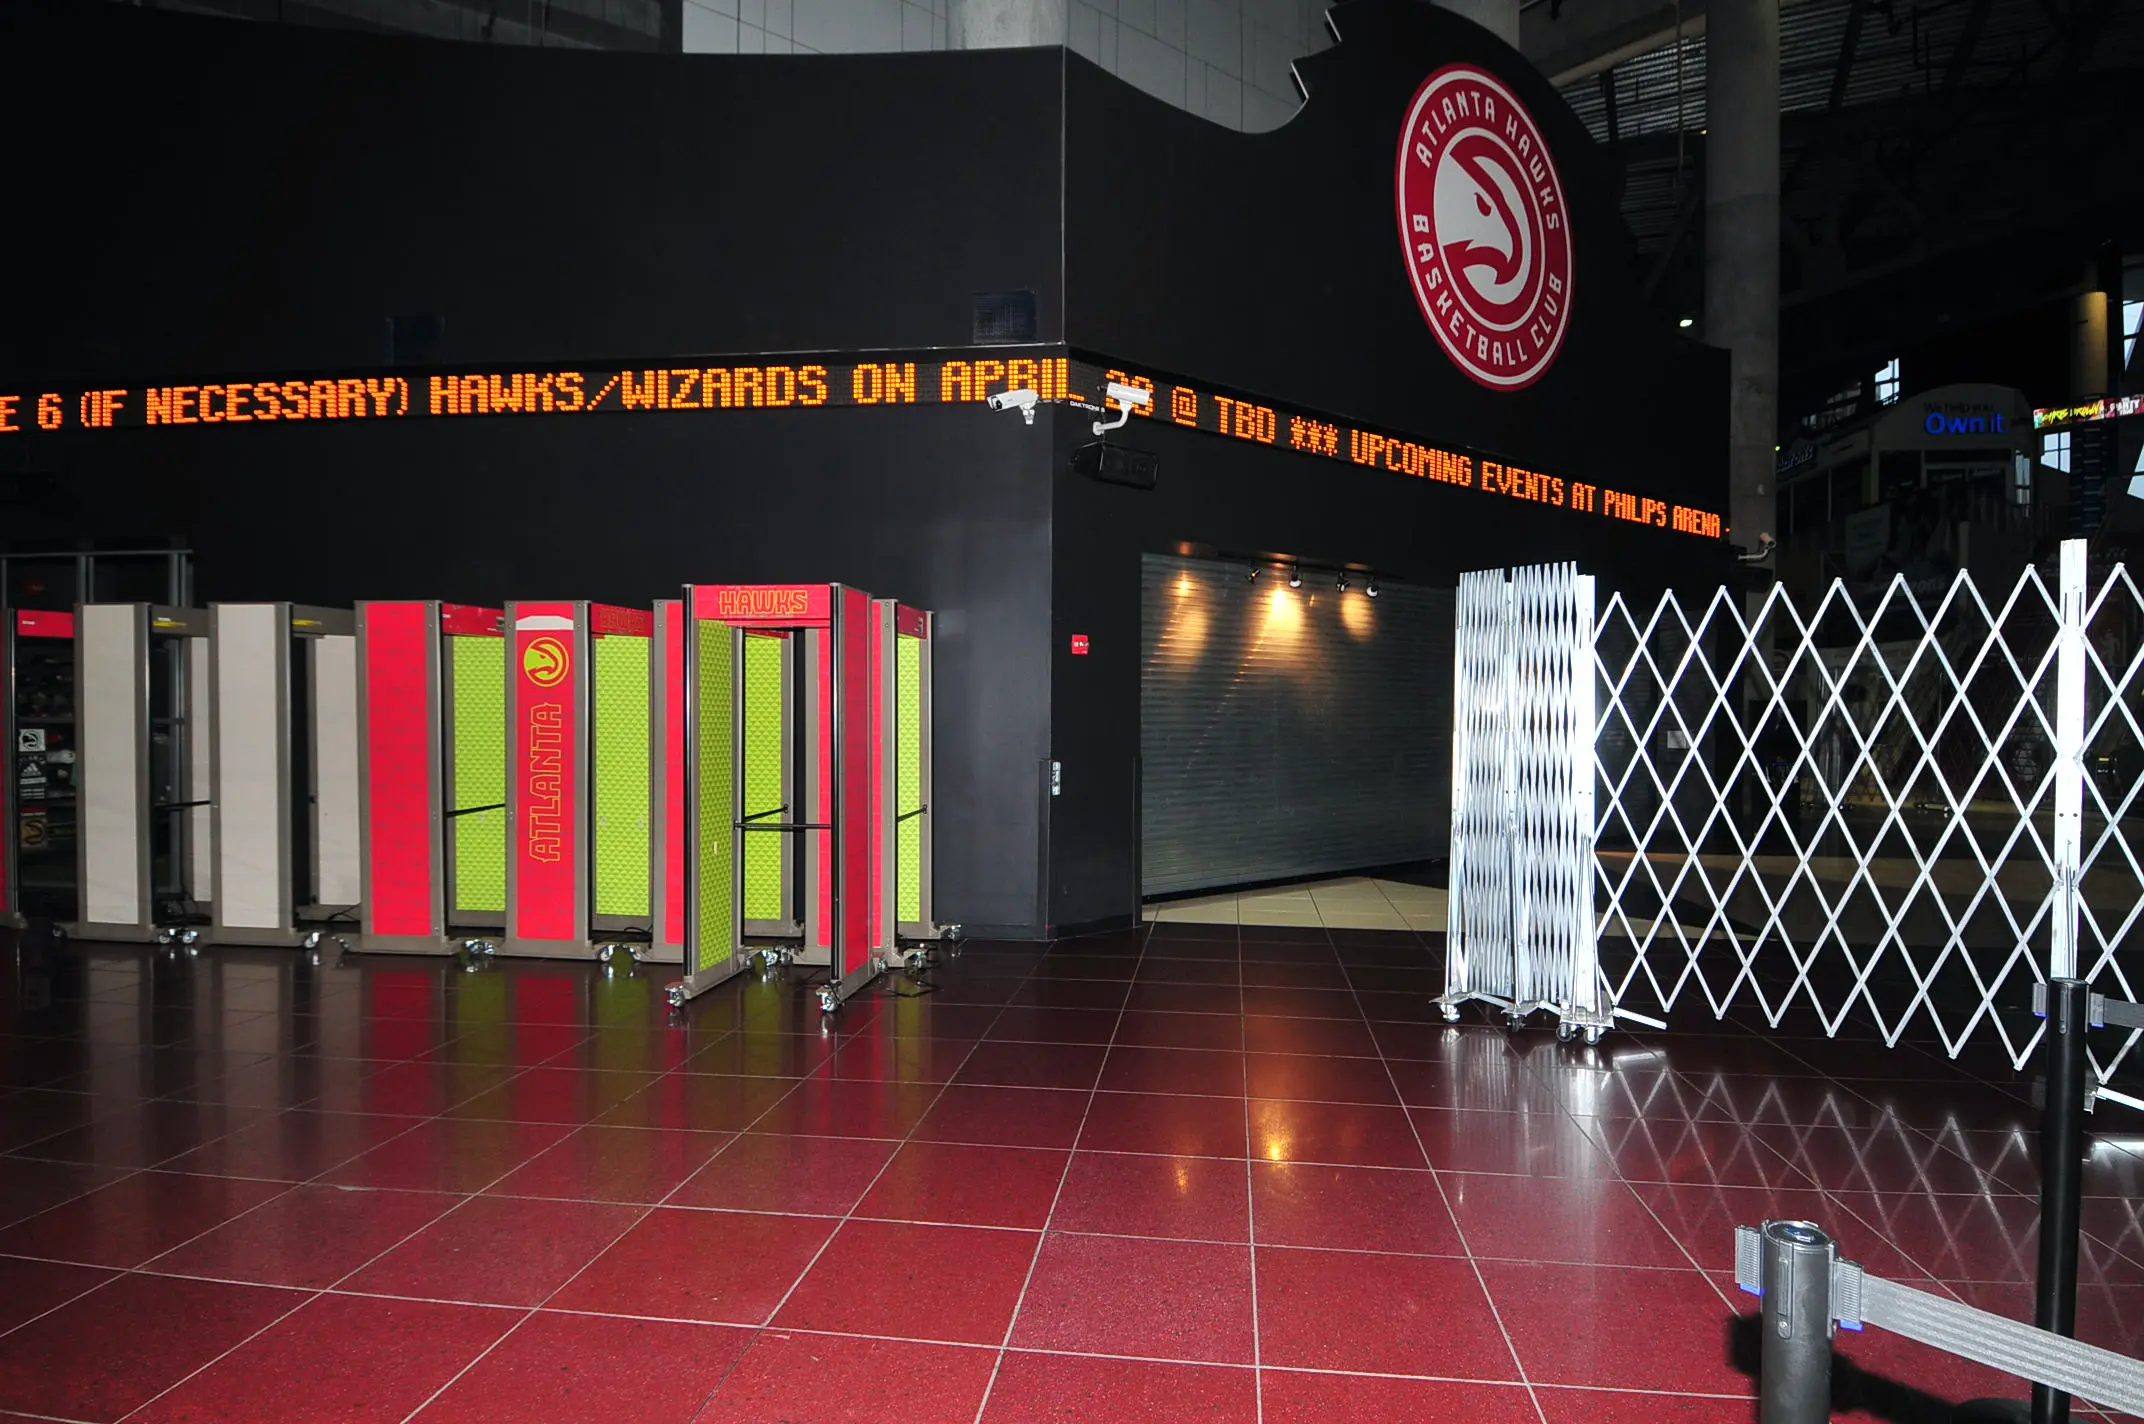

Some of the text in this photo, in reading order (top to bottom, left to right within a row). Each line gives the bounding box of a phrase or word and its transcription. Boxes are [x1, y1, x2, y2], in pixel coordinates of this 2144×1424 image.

[1415, 91, 1560, 230] ATLANTA HAWKS
[1412, 213, 1562, 366] BASKETBALL CLUB
[38, 393, 63, 430] 6
[80, 390, 127, 428] (IF
[147, 377, 408, 425] NECESSARY)
[852, 362, 917, 405] ON
[941, 357, 1085, 403] APRIL
[1171, 385, 1197, 427] @
[1213, 395, 1276, 444] TBD
[1352, 428, 1473, 487] UPCOMING
[1481, 460, 1564, 506] EVENTS
[1571, 482, 1597, 513] AT
[1603, 489, 1667, 527] PHILIPS
[1672, 505, 1721, 539] ARENA
[1924, 412, 1986, 434] Own
[718, 589, 808, 615] HAWKS
[529, 702, 562, 863] ATLANTA
